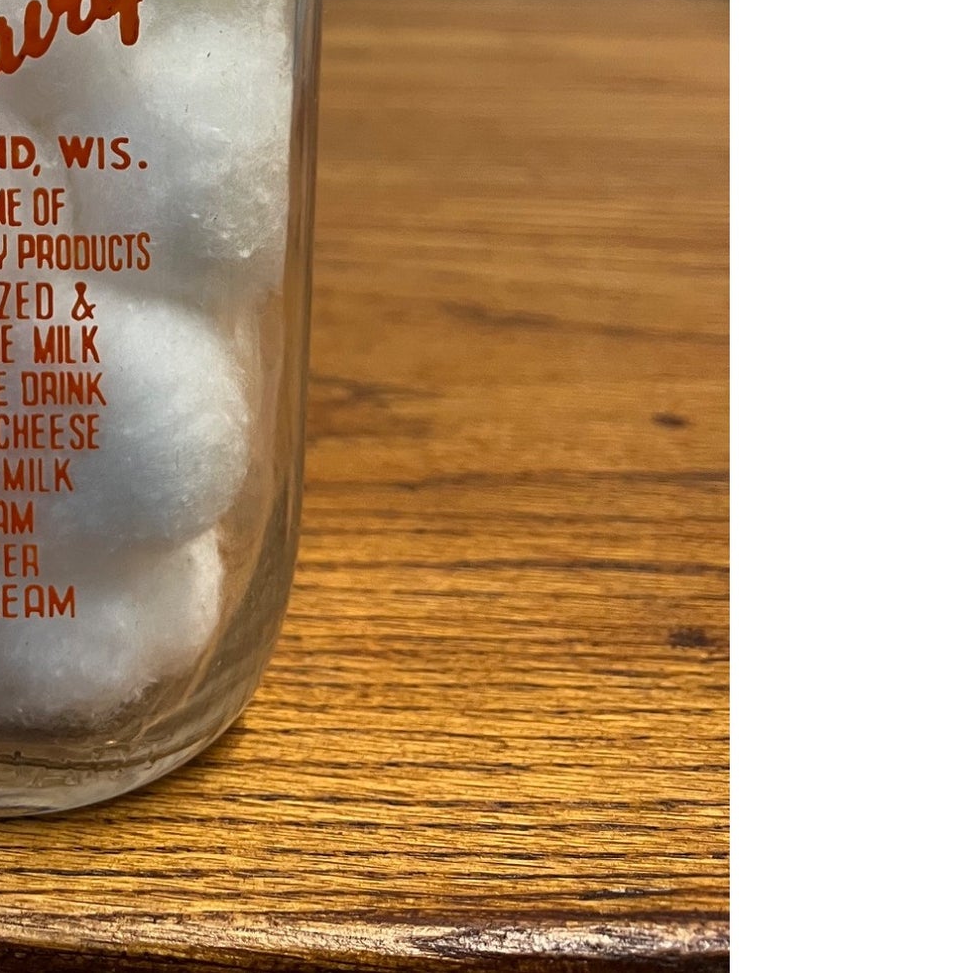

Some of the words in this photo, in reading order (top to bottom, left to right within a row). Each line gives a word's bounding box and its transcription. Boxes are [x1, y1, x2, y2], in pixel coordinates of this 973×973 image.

[58, 135, 148, 170] WIS.
[33, 187, 65, 226] OF
[17, 232, 151, 271] PRODUCTS
[71, 281, 96, 321] &
[33, 324, 100, 364] MILK
[21, 371, 107, 407] DRINK
